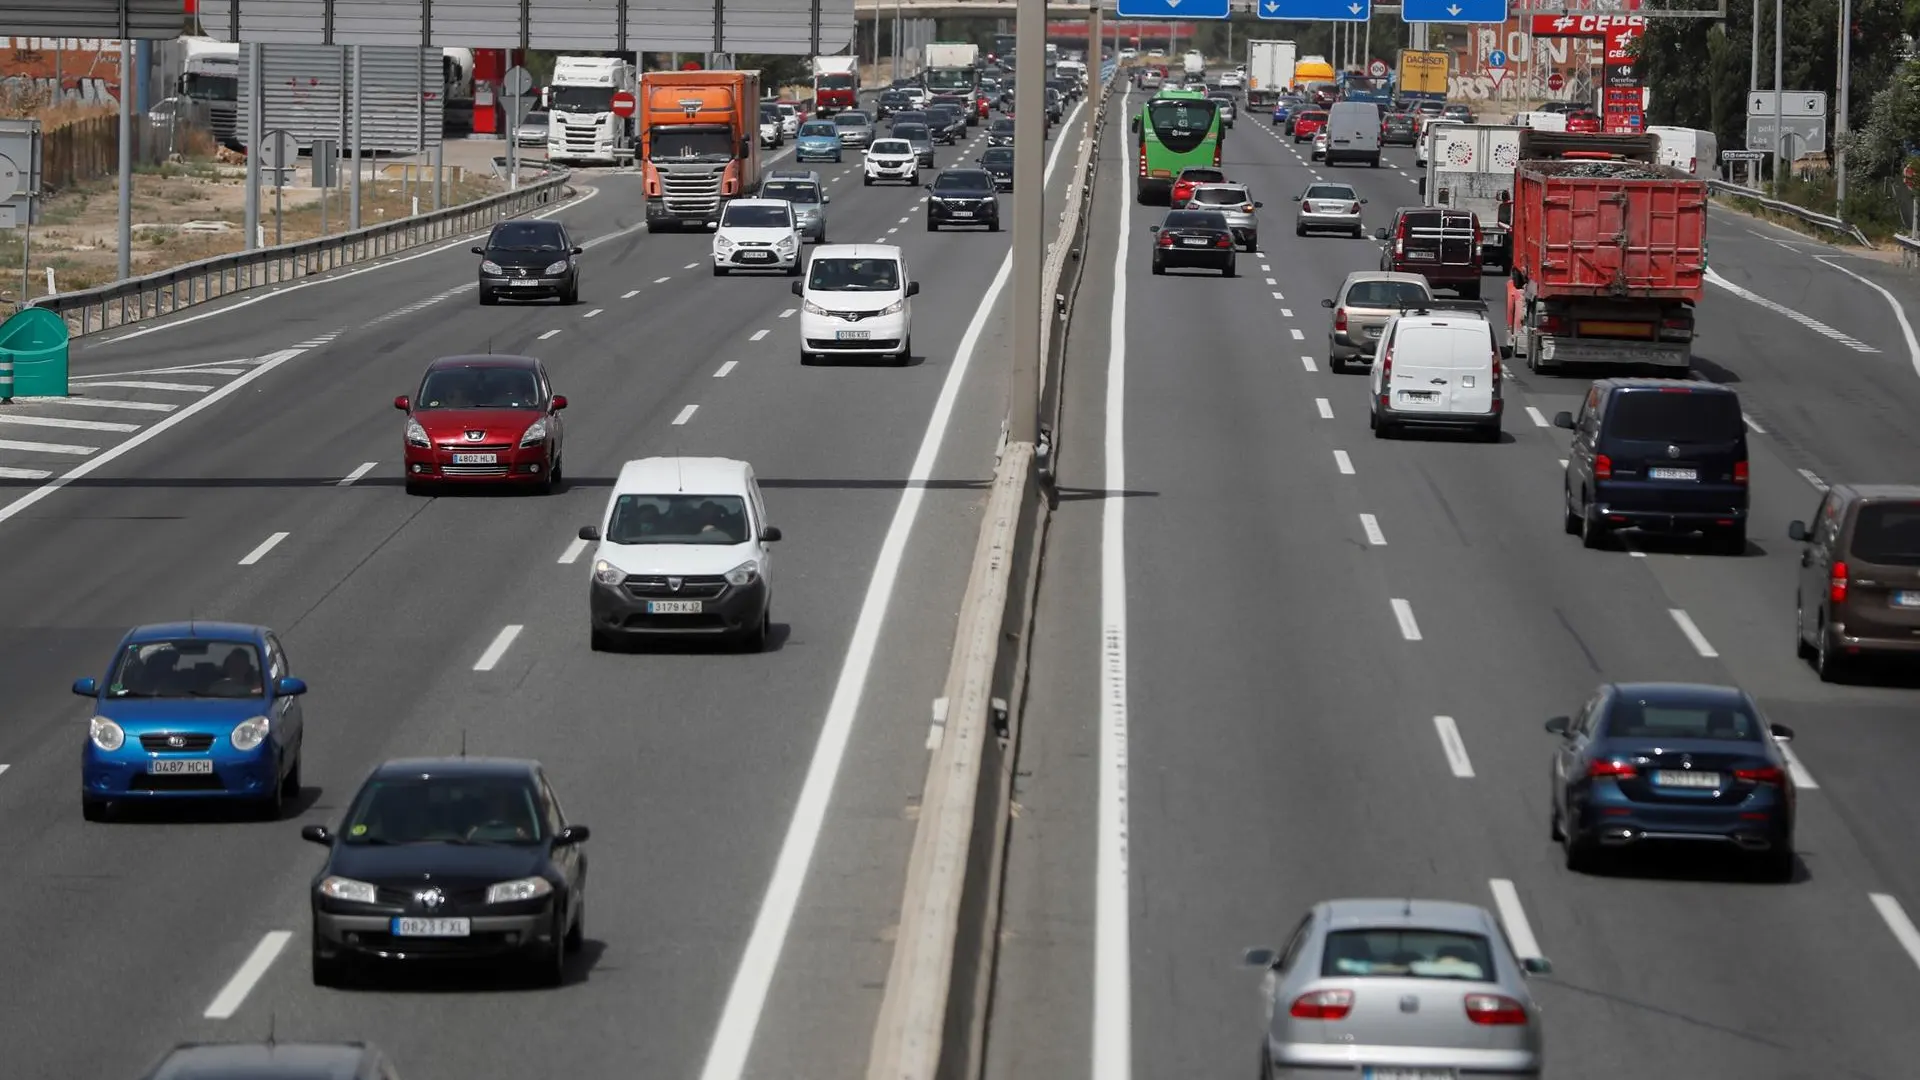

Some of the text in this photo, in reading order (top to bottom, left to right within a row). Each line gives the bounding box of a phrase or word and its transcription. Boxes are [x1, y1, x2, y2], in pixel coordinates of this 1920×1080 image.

[1579, 15, 1649, 32] CEPS
[1406, 55, 1444, 64] DACHSER
[655, 602, 701, 612] 3179 KJZ
[155, 762, 210, 772] 0487 HCH
[402, 920, 435, 932] 0823
